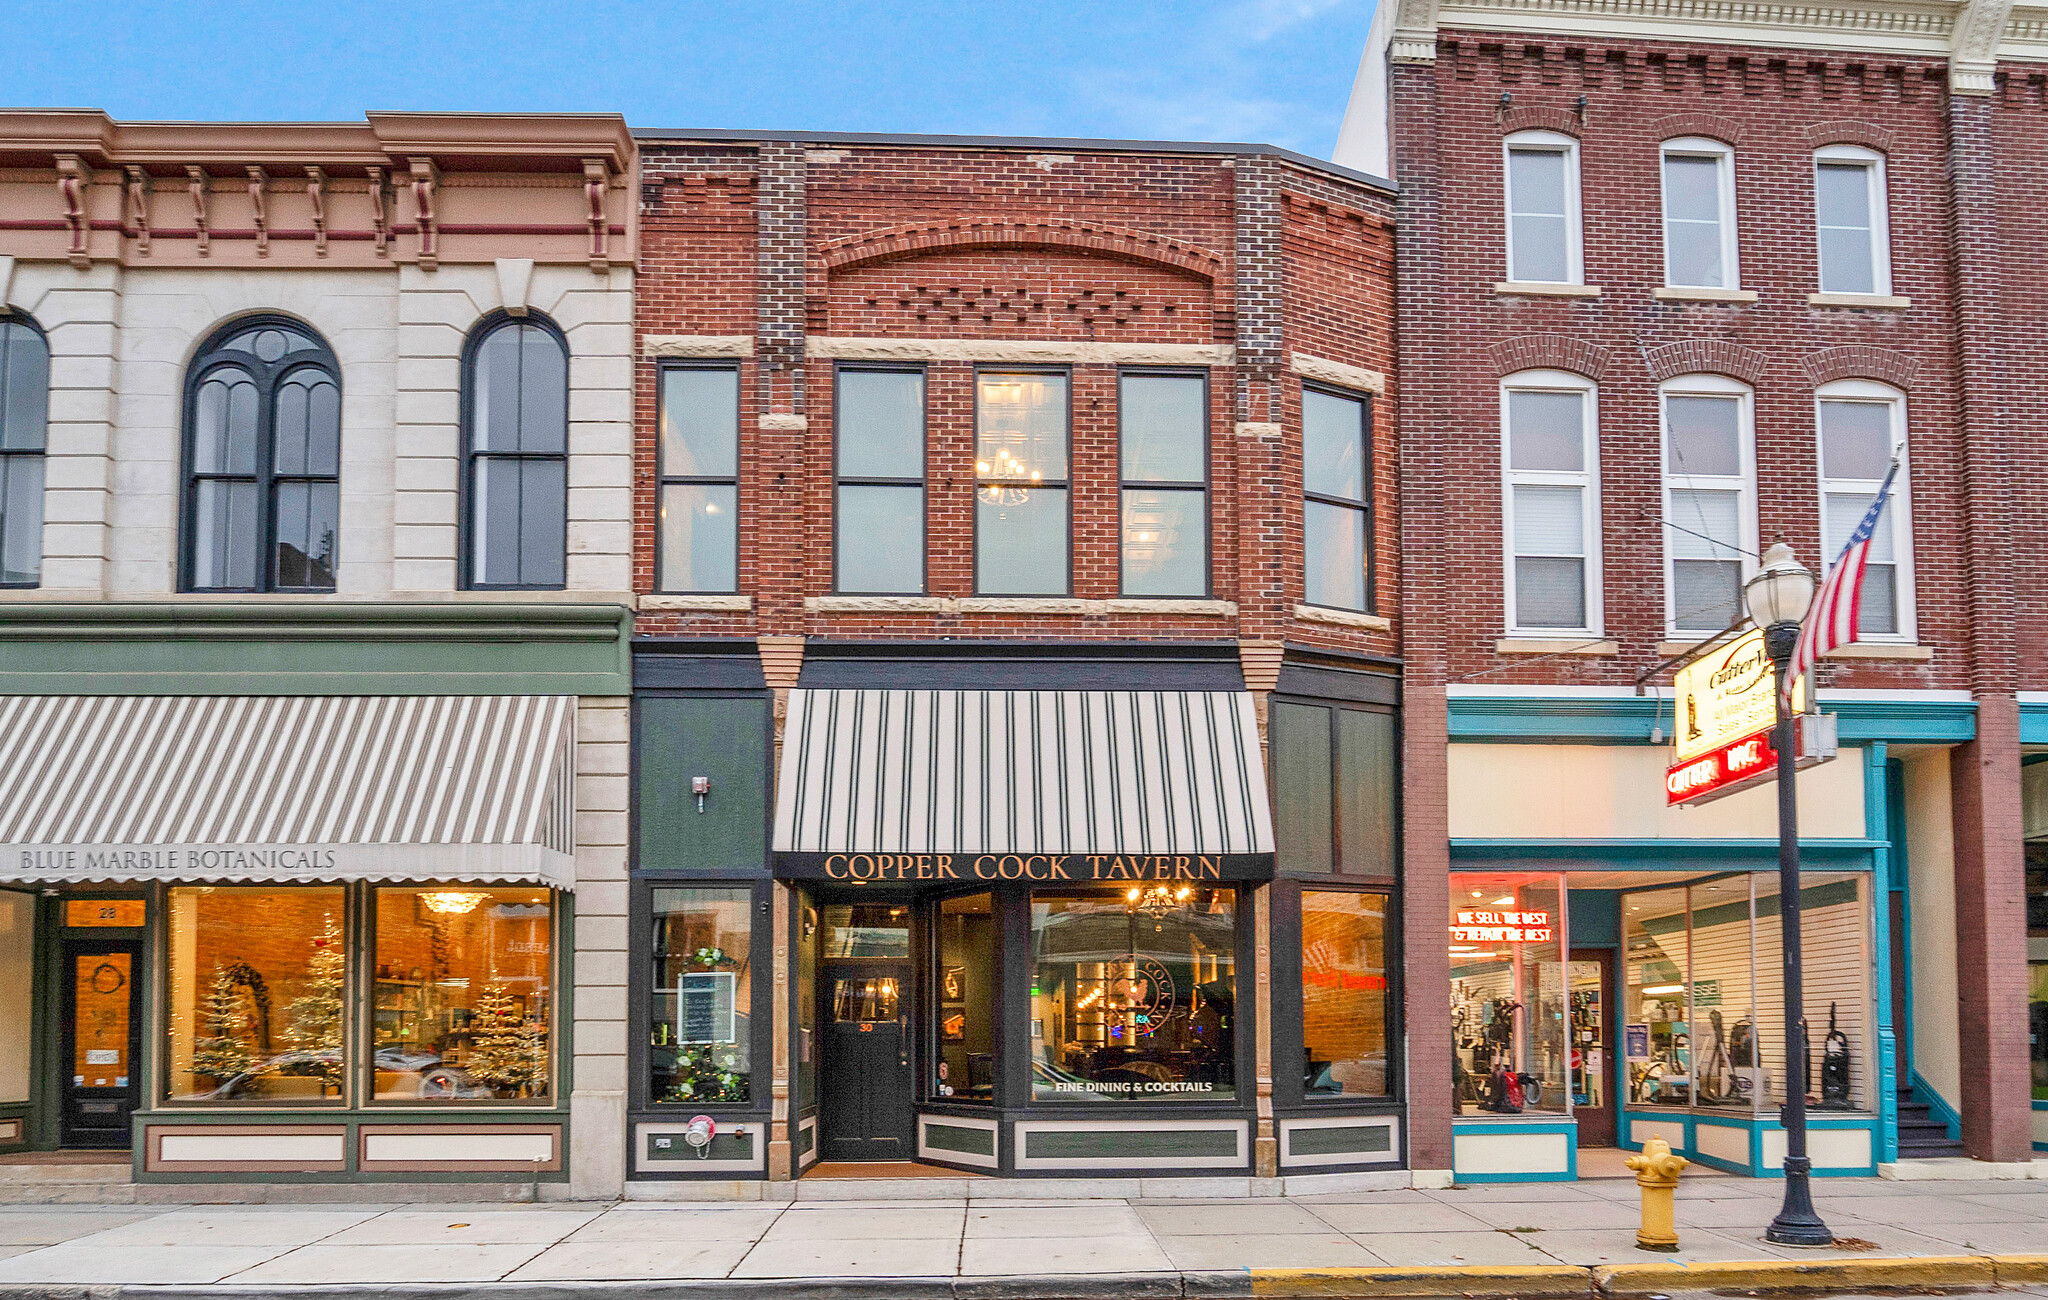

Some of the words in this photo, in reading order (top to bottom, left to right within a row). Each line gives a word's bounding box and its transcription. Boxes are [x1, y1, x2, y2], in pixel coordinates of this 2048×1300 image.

[20, 850, 76, 869] BLUE
[84, 850, 179, 869] MARBLE
[187, 850, 335, 869] BOTANICALS
[825, 854, 960, 880] COPPER
[973, 855, 1071, 880] COCK
[1086, 855, 1222, 880] TAVERN
[1457, 911, 1475, 924] WE
[1475, 911, 1502, 924] SELL
[1502, 912, 1522, 925] THE
[1521, 912, 1548, 925] BEST
[1466, 928, 1503, 941] REPAIR
[1504, 928, 1524, 941] THE
[860, 1024, 873, 1032] 30
[1055, 1082, 1083, 1092] FINE
[1085, 1082, 1131, 1092] DINING
[1133, 1082, 1142, 1092] &
[1144, 1082, 1213, 1092] COCKTAILS
